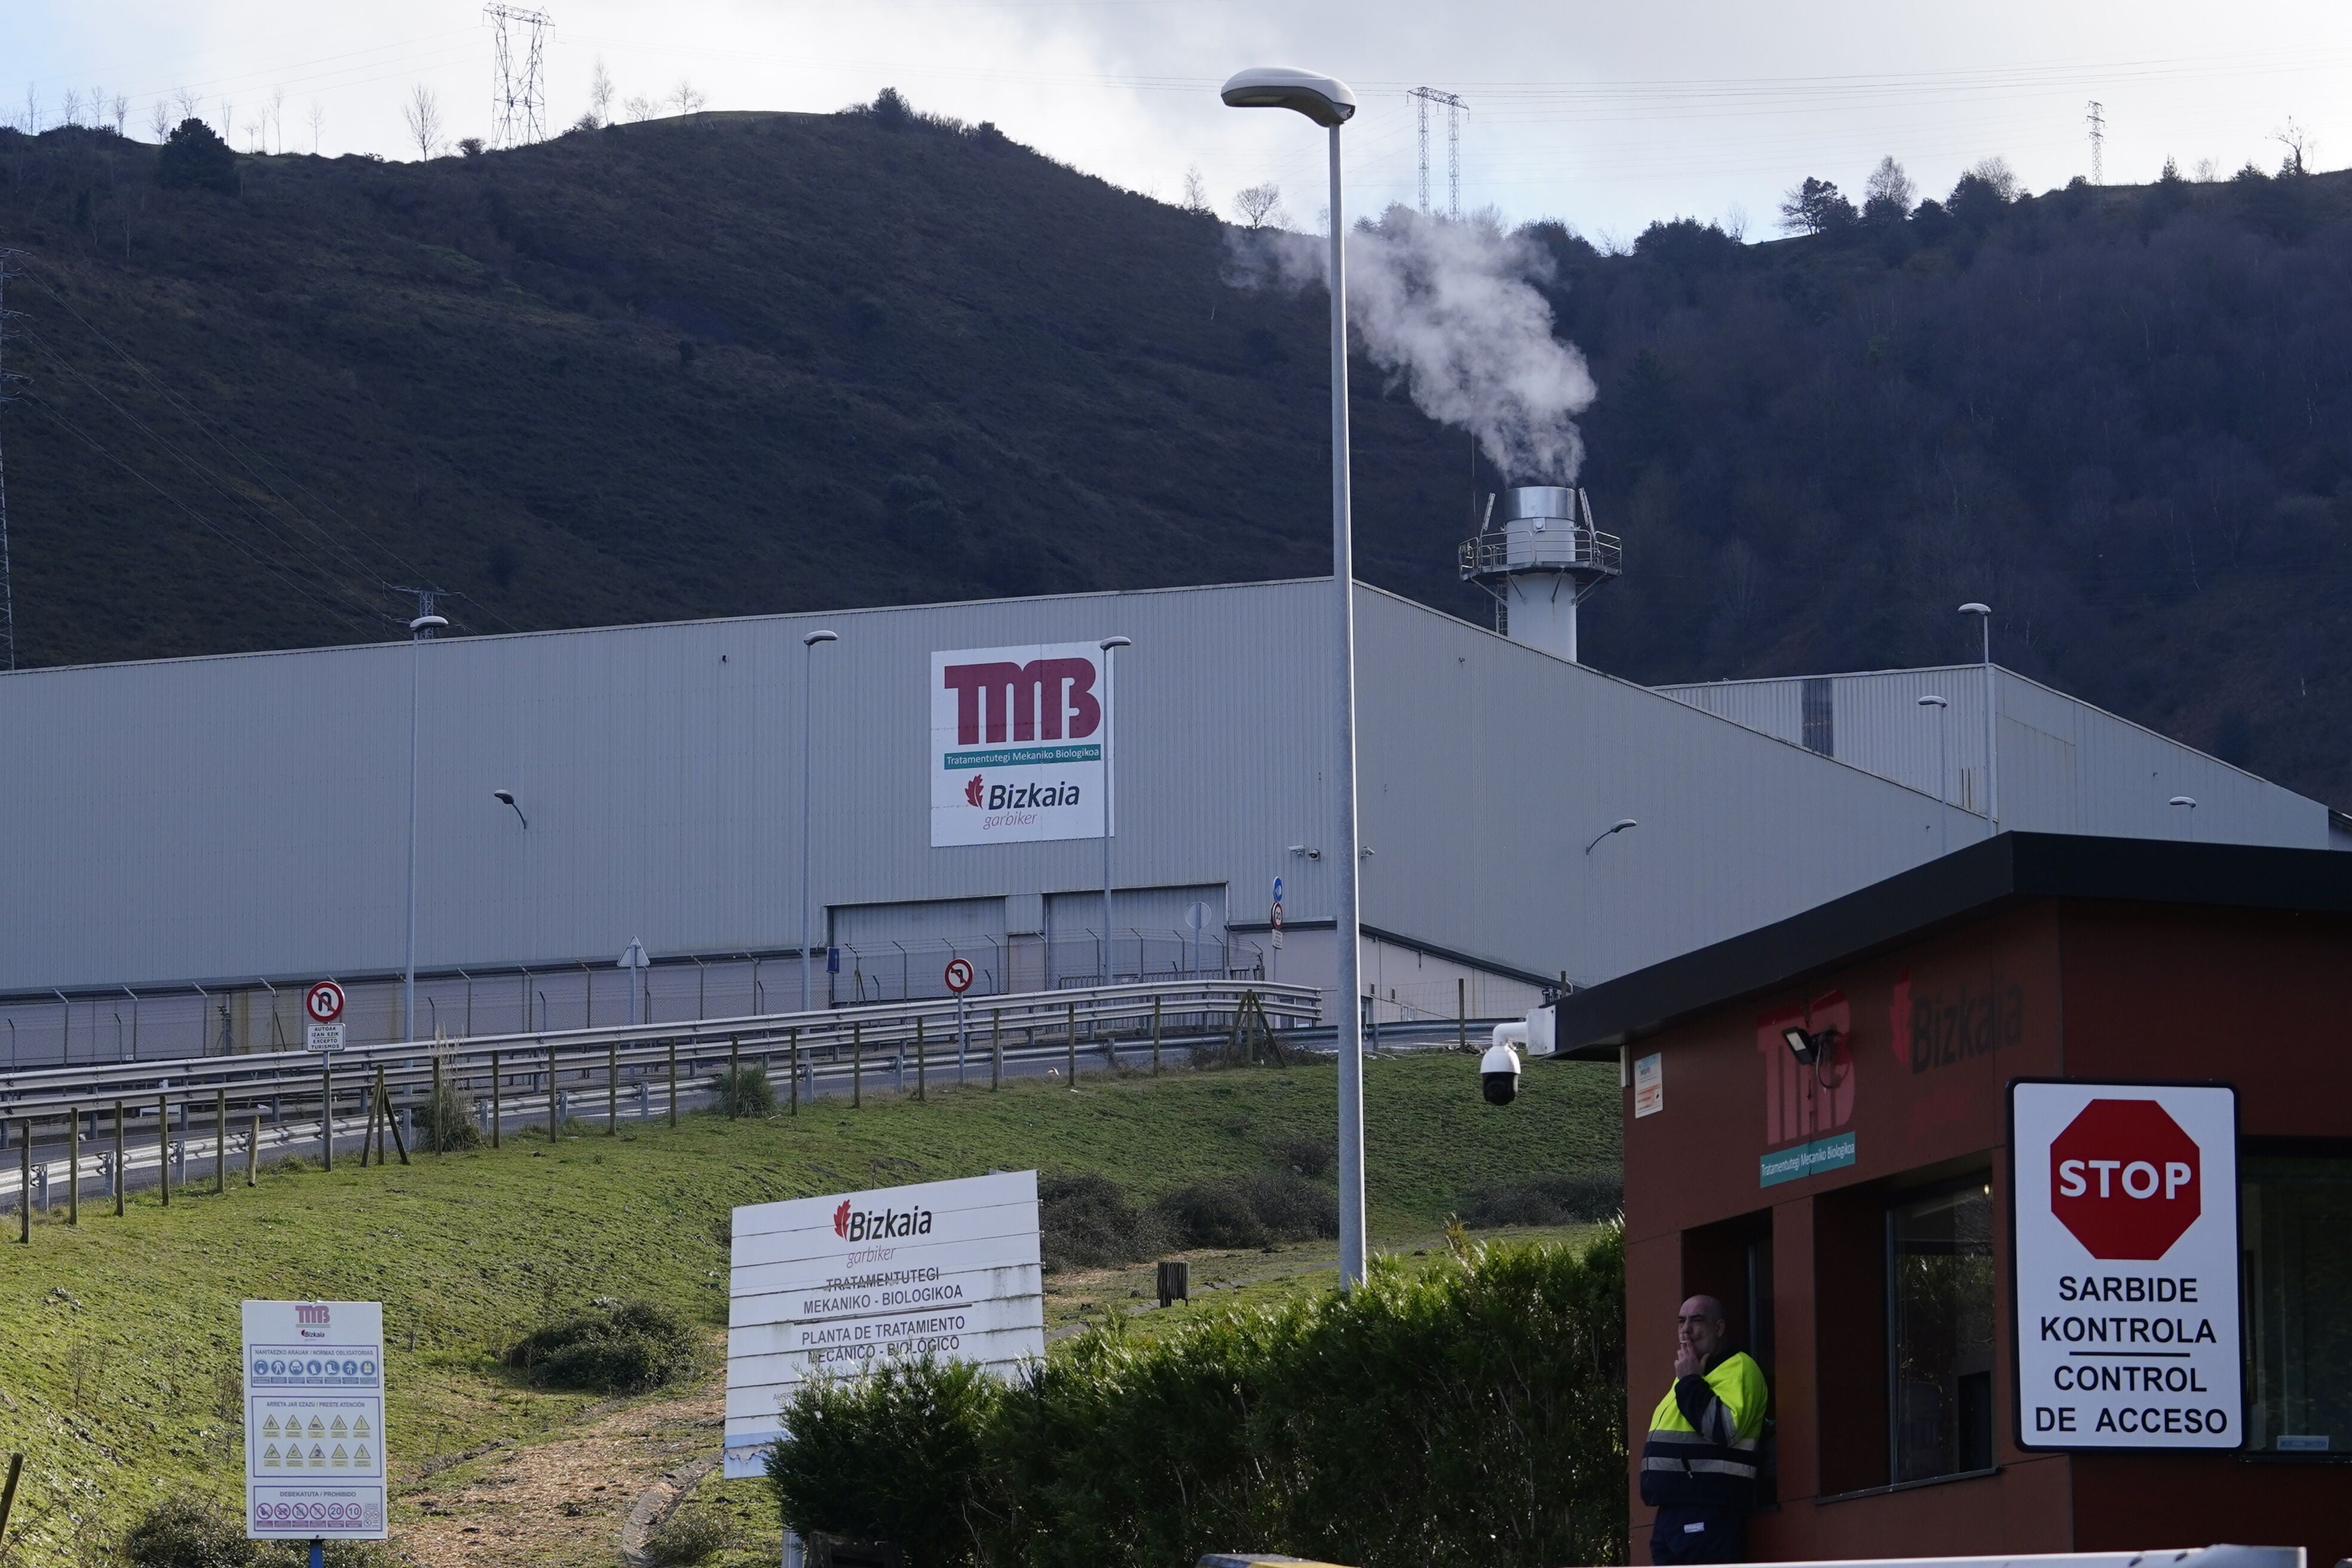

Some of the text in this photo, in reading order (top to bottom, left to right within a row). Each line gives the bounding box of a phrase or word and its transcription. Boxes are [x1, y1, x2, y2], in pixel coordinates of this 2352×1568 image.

[944, 657, 1101, 745] TMB
[947, 747, 1100, 765] Tratamentutegi Mekaniko Biologikoa
[988, 781, 1080, 810] Bizkaia
[983, 811, 1038, 830] garbiker
[1912, 983, 2023, 1075] Bizkaia
[1761, 1154, 1800, 1177] Tratamentutegi
[1827, 1141, 1855, 1159] Biologikoa
[2059, 1159, 2192, 1200] STOP
[849, 1206, 932, 1242] Bizkaia
[846, 1245, 896, 1268] garbiker
[826, 1267, 939, 1292] TRATAMENTUTEGI
[2059, 1276, 2198, 1303] SARBIDE
[804, 1294, 871, 1314] MEKANIKO
[882, 1285, 963, 1306] BIOLOGIKOA
[295, 1305, 330, 1324] TMB
[802, 1316, 965, 1346] PLANTA DE TRATAMIENTO
[2041, 1316, 2217, 1344] KONTROLA
[887, 1336, 960, 1356] BIOLÓGICO
[2054, 1365, 2207, 1392] CONTROL
[2036, 1407, 2227, 1434] DE ACCESO
[330, 1507, 359, 1515] 20 10
